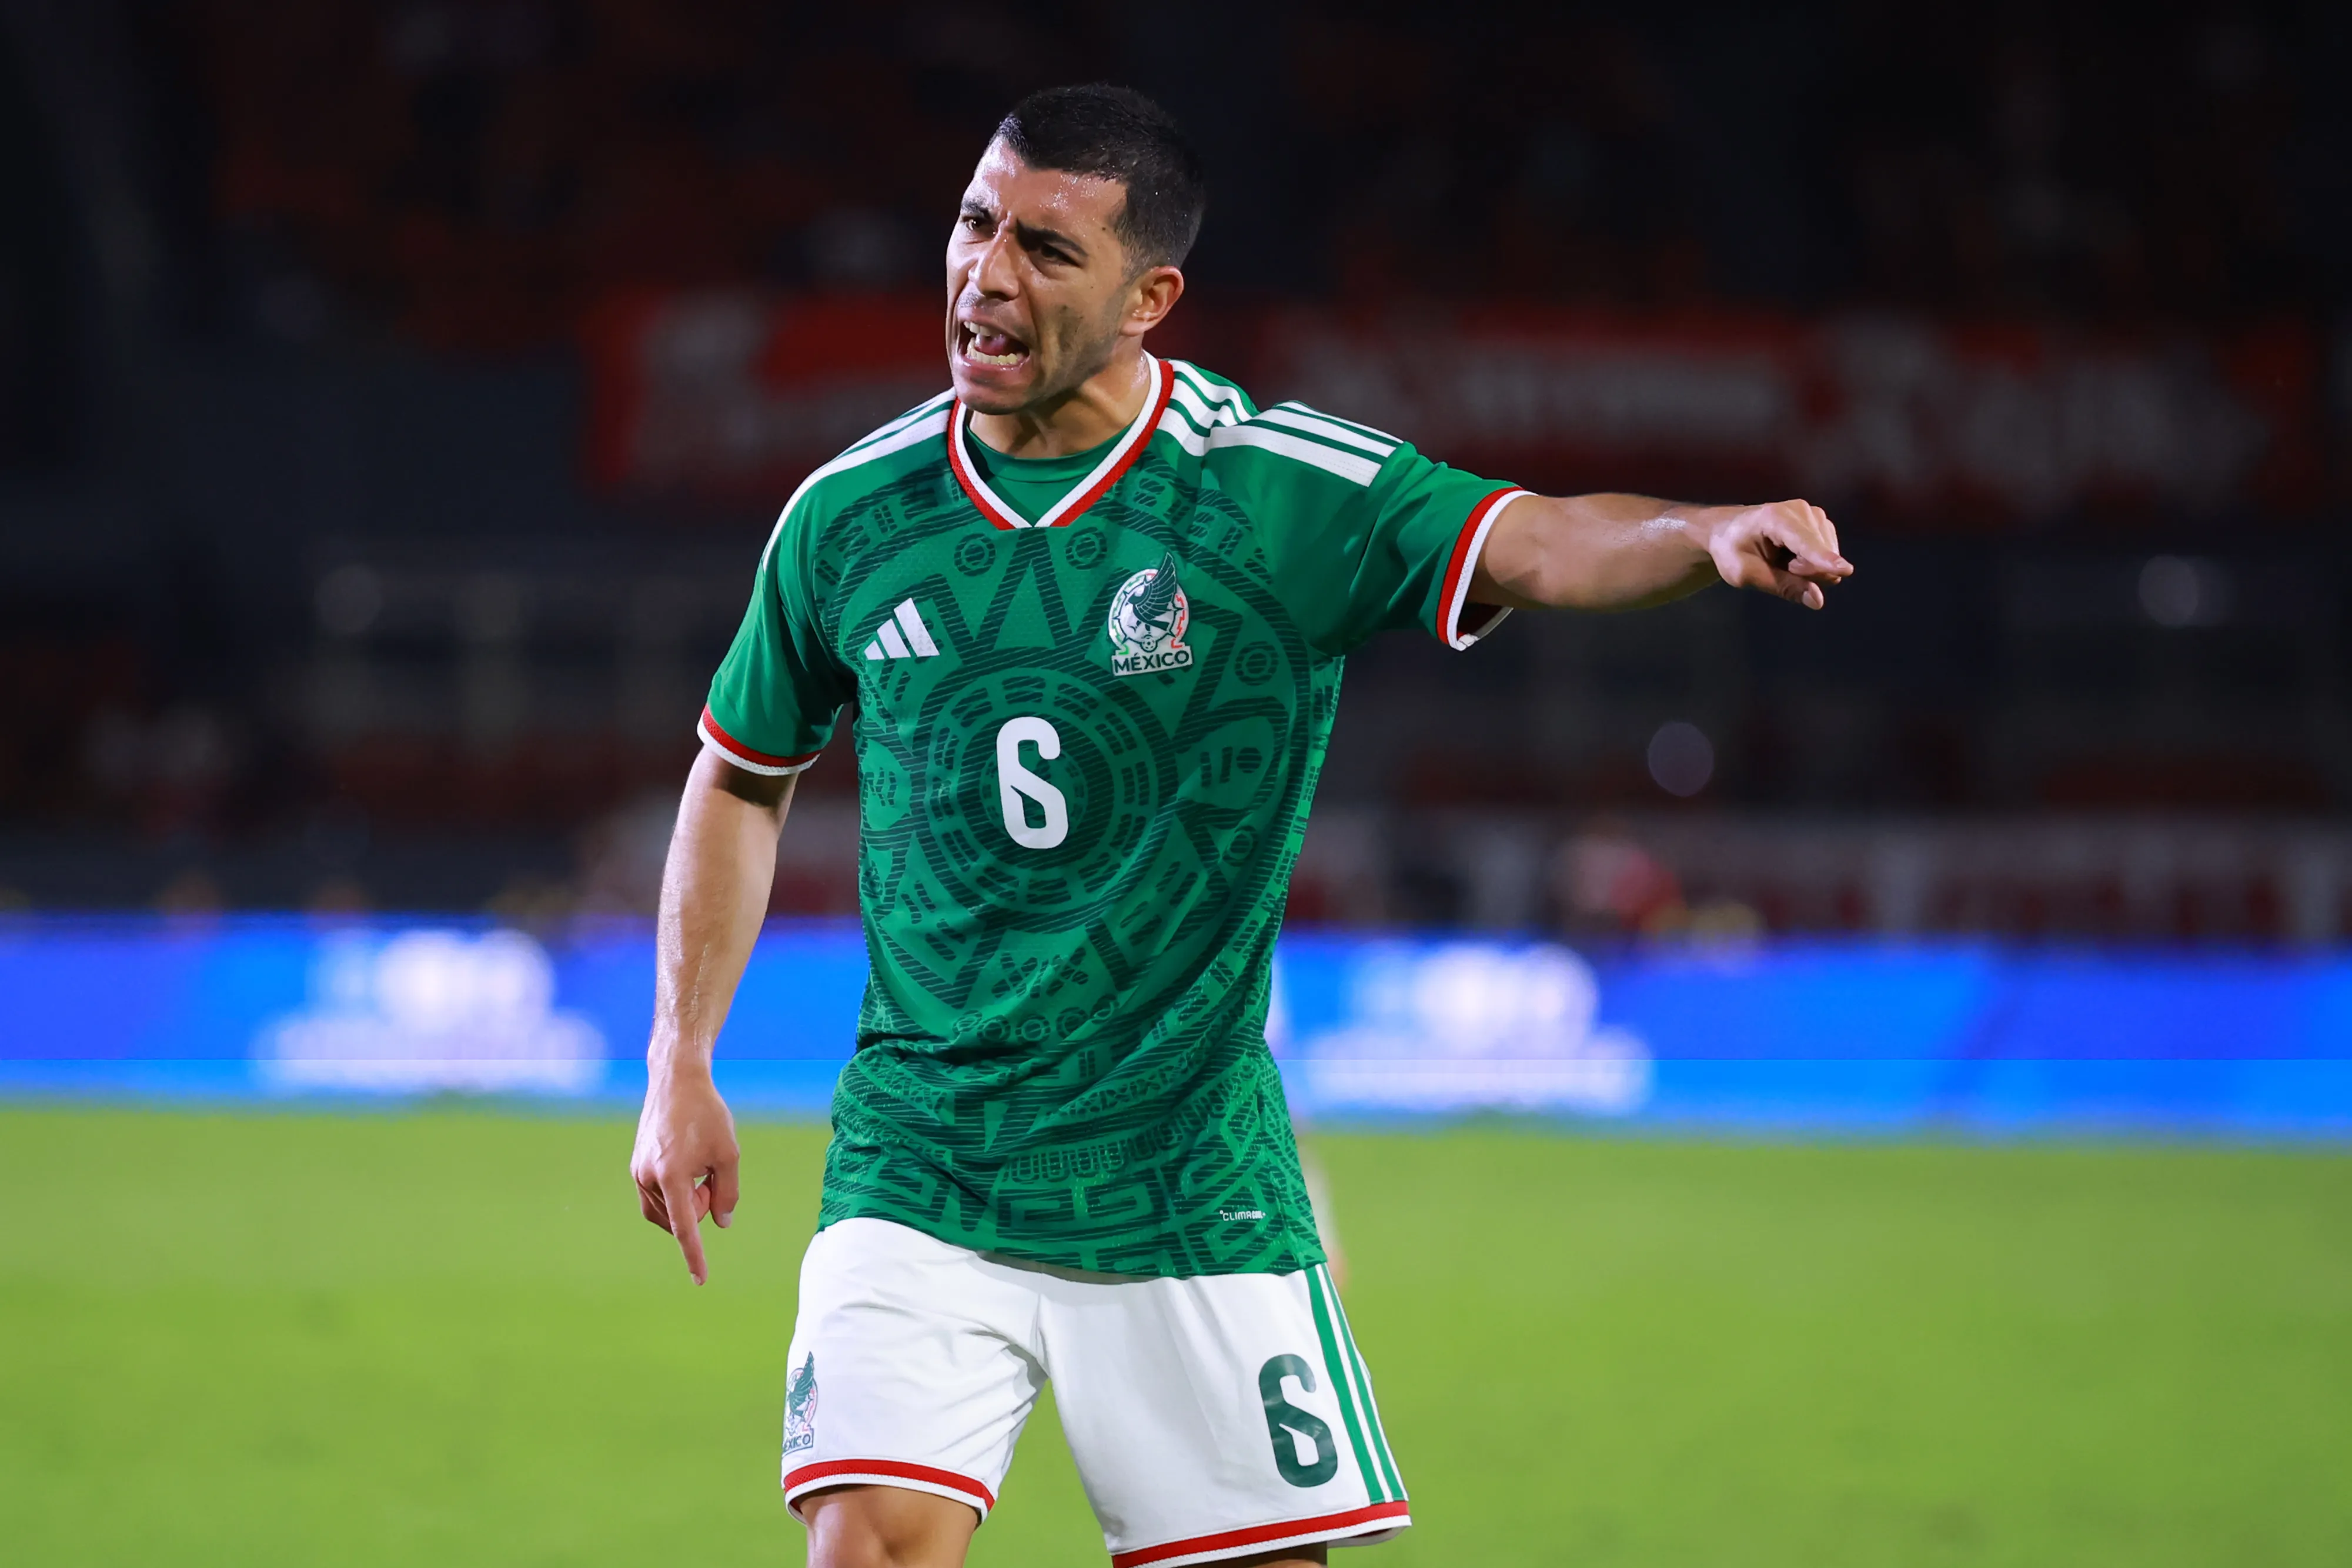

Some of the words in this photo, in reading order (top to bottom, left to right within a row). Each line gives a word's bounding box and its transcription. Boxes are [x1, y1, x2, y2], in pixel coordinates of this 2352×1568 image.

[1114, 650, 1190, 673] MÉXICO
[996, 716, 1068, 849] 6
[1258, 1353, 1338, 1488] 6
